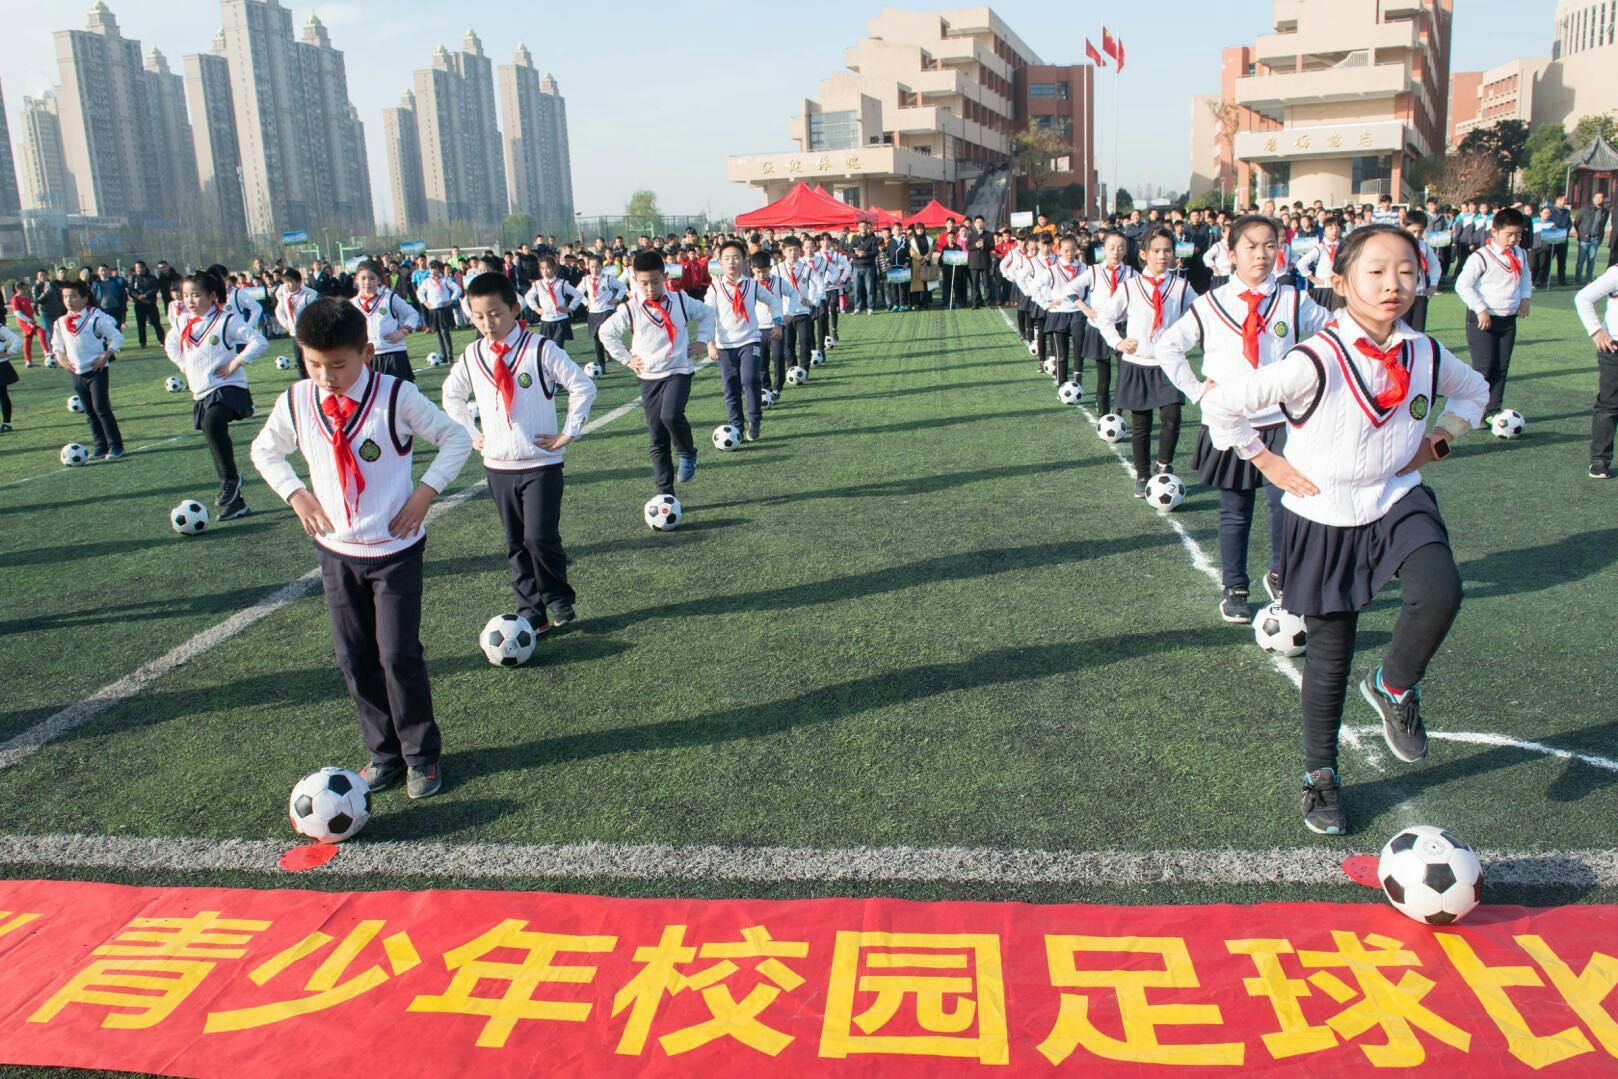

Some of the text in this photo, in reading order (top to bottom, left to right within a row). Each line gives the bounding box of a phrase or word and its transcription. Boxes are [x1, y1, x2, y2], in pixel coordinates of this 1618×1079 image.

[0, 911, 1618, 1070] 青少年校园足球比
